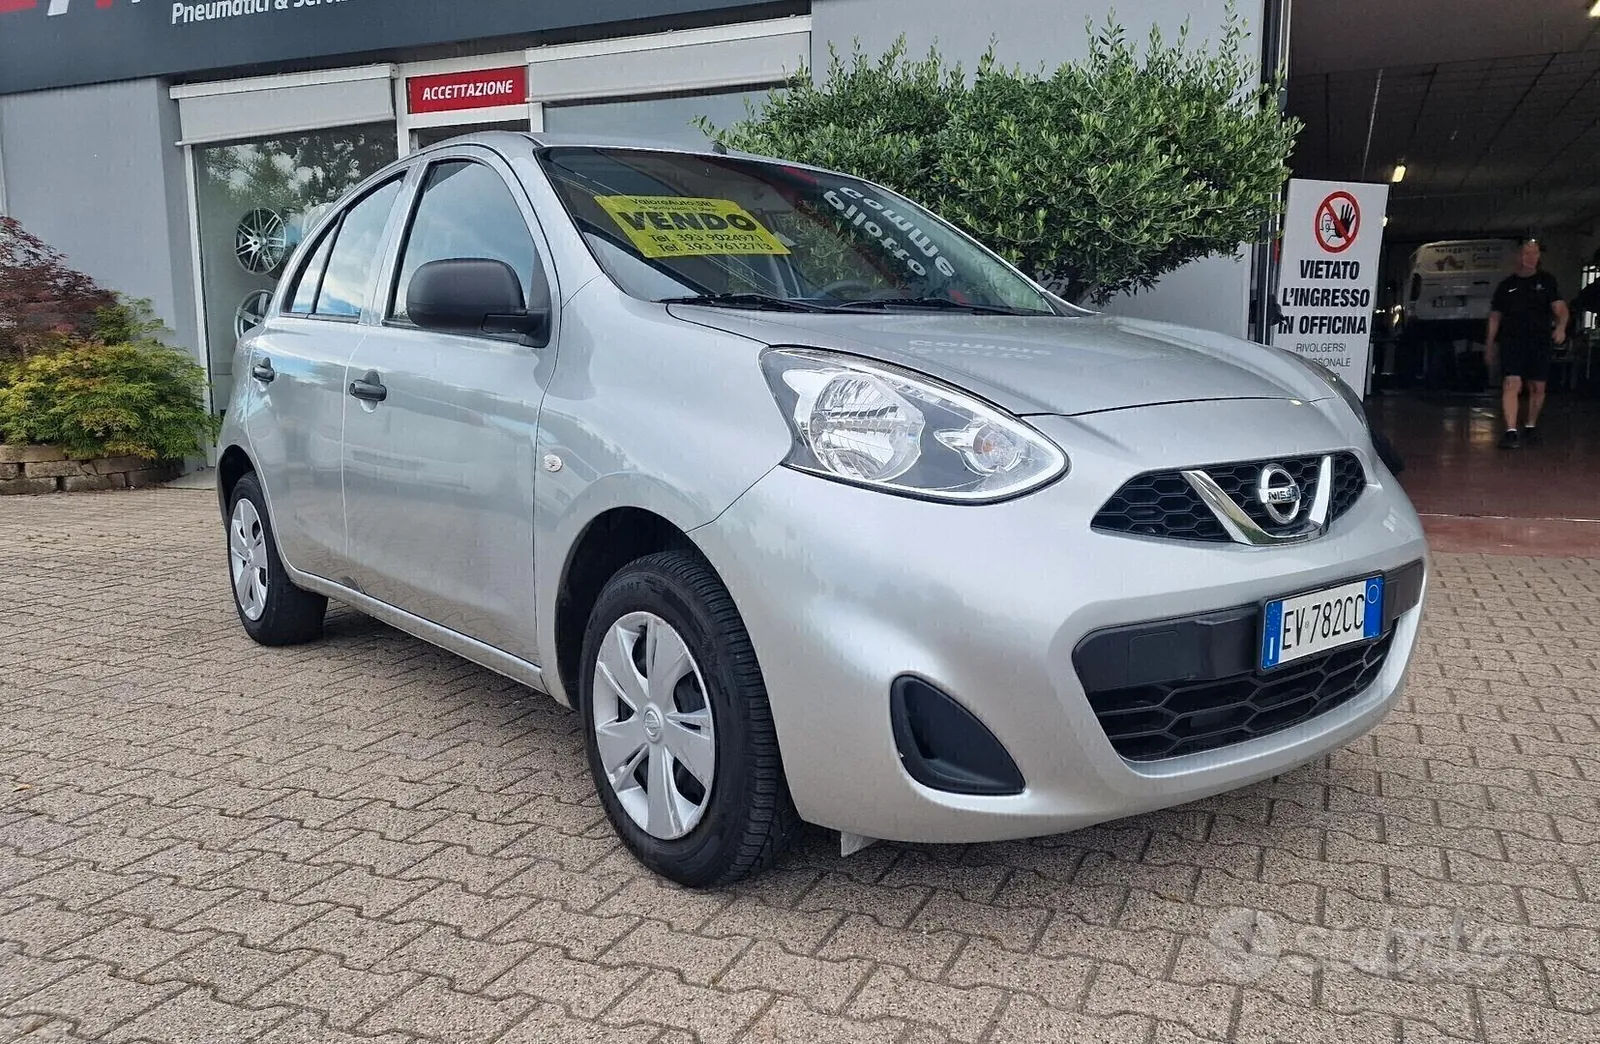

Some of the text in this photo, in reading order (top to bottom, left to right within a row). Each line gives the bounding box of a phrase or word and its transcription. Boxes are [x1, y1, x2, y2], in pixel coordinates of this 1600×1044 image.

[422, 79, 513, 100] ACCETTAZIONE
[617, 211, 758, 231] VENDO
[649, 234, 675, 243] Tel.
[657, 243, 683, 252] Tel.
[1300, 260, 1360, 280] VIETATO
[1282, 287, 1371, 308] L'INGRESSO
[1299, 315, 1367, 335] OFFICINA
[1296, 342, 1347, 353] RIVOLGERSI
